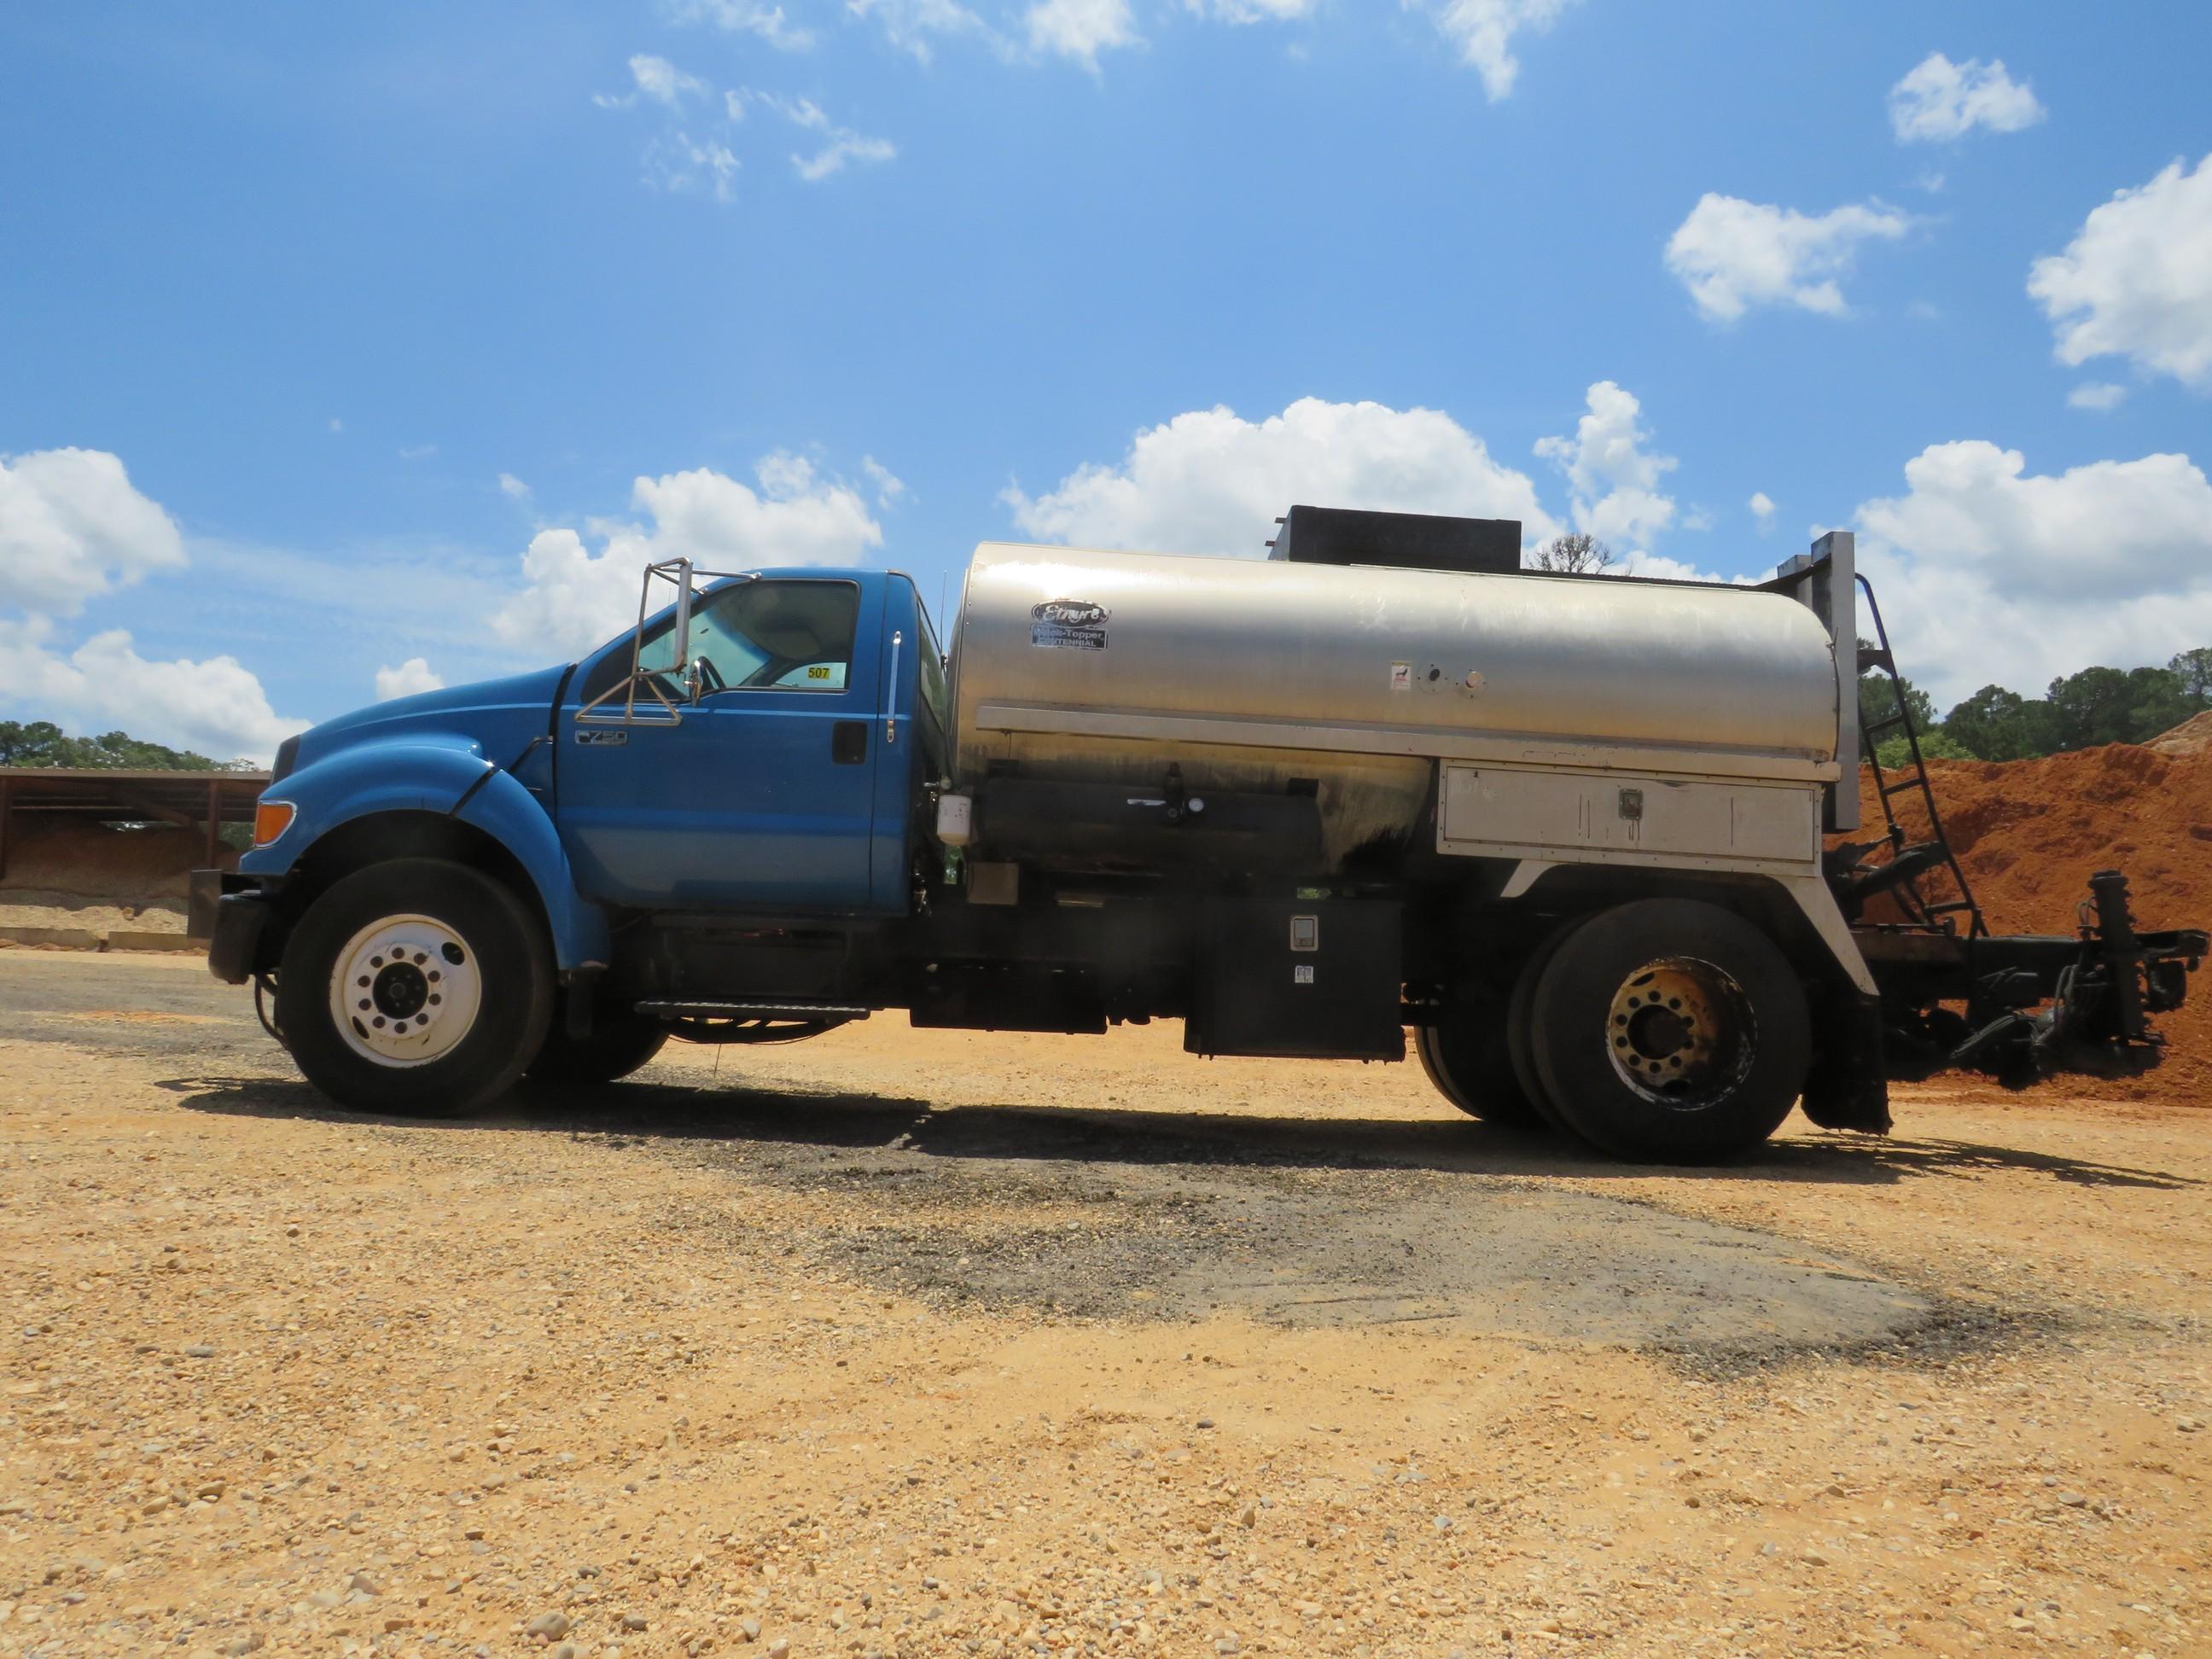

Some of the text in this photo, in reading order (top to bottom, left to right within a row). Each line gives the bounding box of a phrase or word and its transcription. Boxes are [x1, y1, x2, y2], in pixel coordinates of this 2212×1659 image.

[1034, 627, 1102, 639] ck-Topper
[1038, 637, 1097, 646] NTENNIAL
[808, 668, 830, 679] 507
